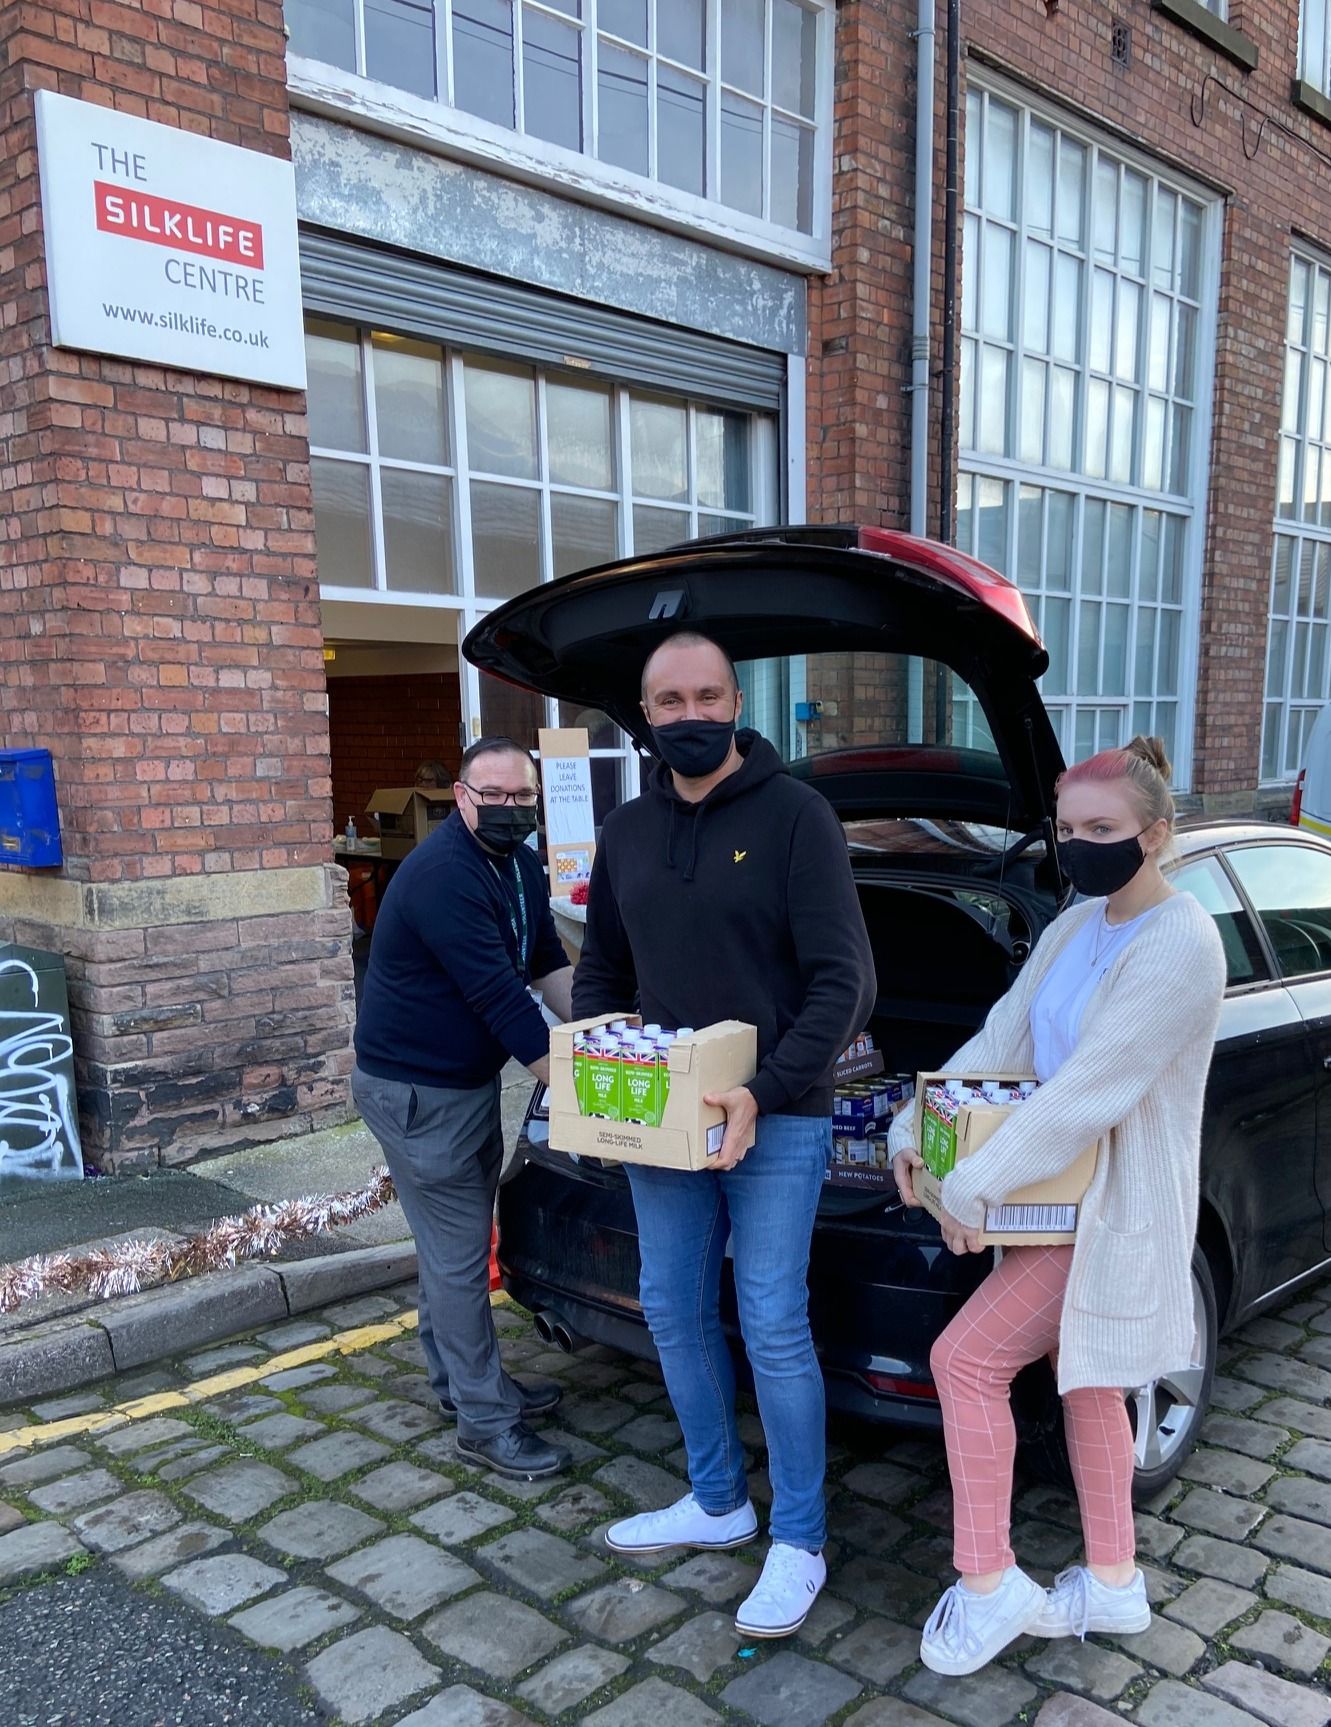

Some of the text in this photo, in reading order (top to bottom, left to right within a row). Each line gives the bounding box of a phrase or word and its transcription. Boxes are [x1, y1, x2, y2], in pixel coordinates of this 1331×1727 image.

[91, 142, 148, 182] THE
[105, 195, 255, 257] SILKLIFE
[164, 258, 265, 304] CENTRE
[102, 302, 269, 349] www.silklife.co.uk
[556, 761, 577, 770] PLEASE
[559, 773, 577, 781] LEAVE
[550, 784, 586, 793] DONATIONS
[550, 794, 588, 804] AT THE TABLE
[836, 1061, 873, 1078] SLICED CARROTS
[592, 1073, 614, 1084] LONG
[628, 1078, 651, 1089] LONG
[595, 1082, 611, 1091] LIFE
[631, 1087, 647, 1097] LIFE
[598, 1131, 642, 1143] SEMI-SKIMMED
[596, 1137, 644, 1150] LONG-LIFE MILK
[838, 1170, 853, 1178] NEW
[853, 1171, 884, 1182] POTATOES
